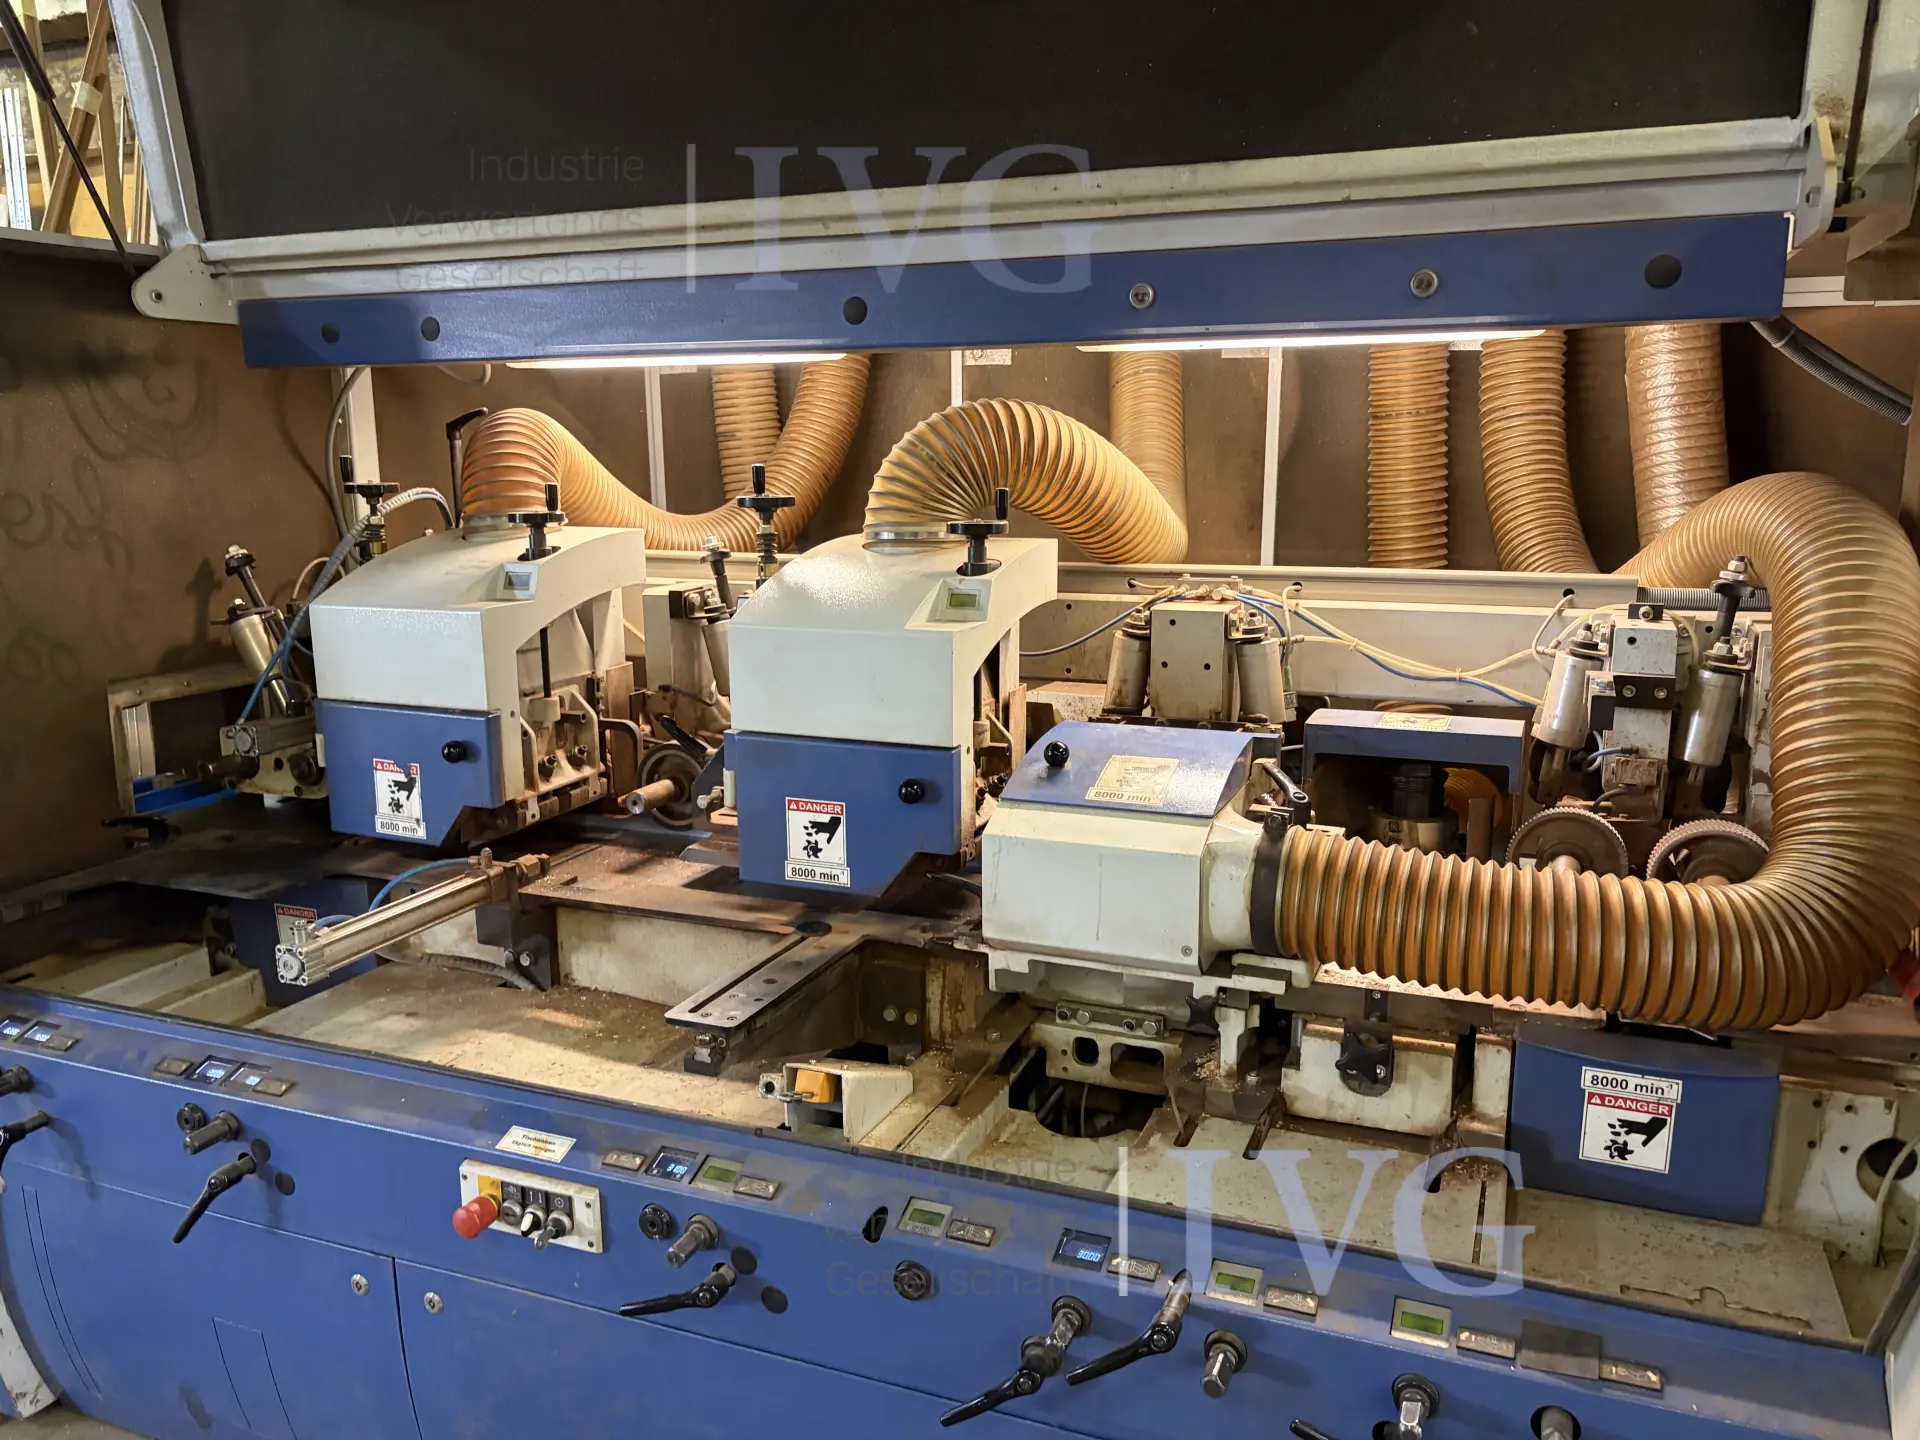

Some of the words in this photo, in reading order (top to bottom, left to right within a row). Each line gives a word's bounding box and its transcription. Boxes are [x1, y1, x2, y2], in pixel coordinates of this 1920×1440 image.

[1094, 791, 1124, 800] 8000
[799, 801, 843, 814] DANGER
[380, 820, 400, 833] 8000
[791, 866, 816, 878] 8000
[284, 907, 315, 918] DANGER
[1590, 1074, 1629, 1090] 8000
[1604, 1096, 1670, 1115] DANGER
